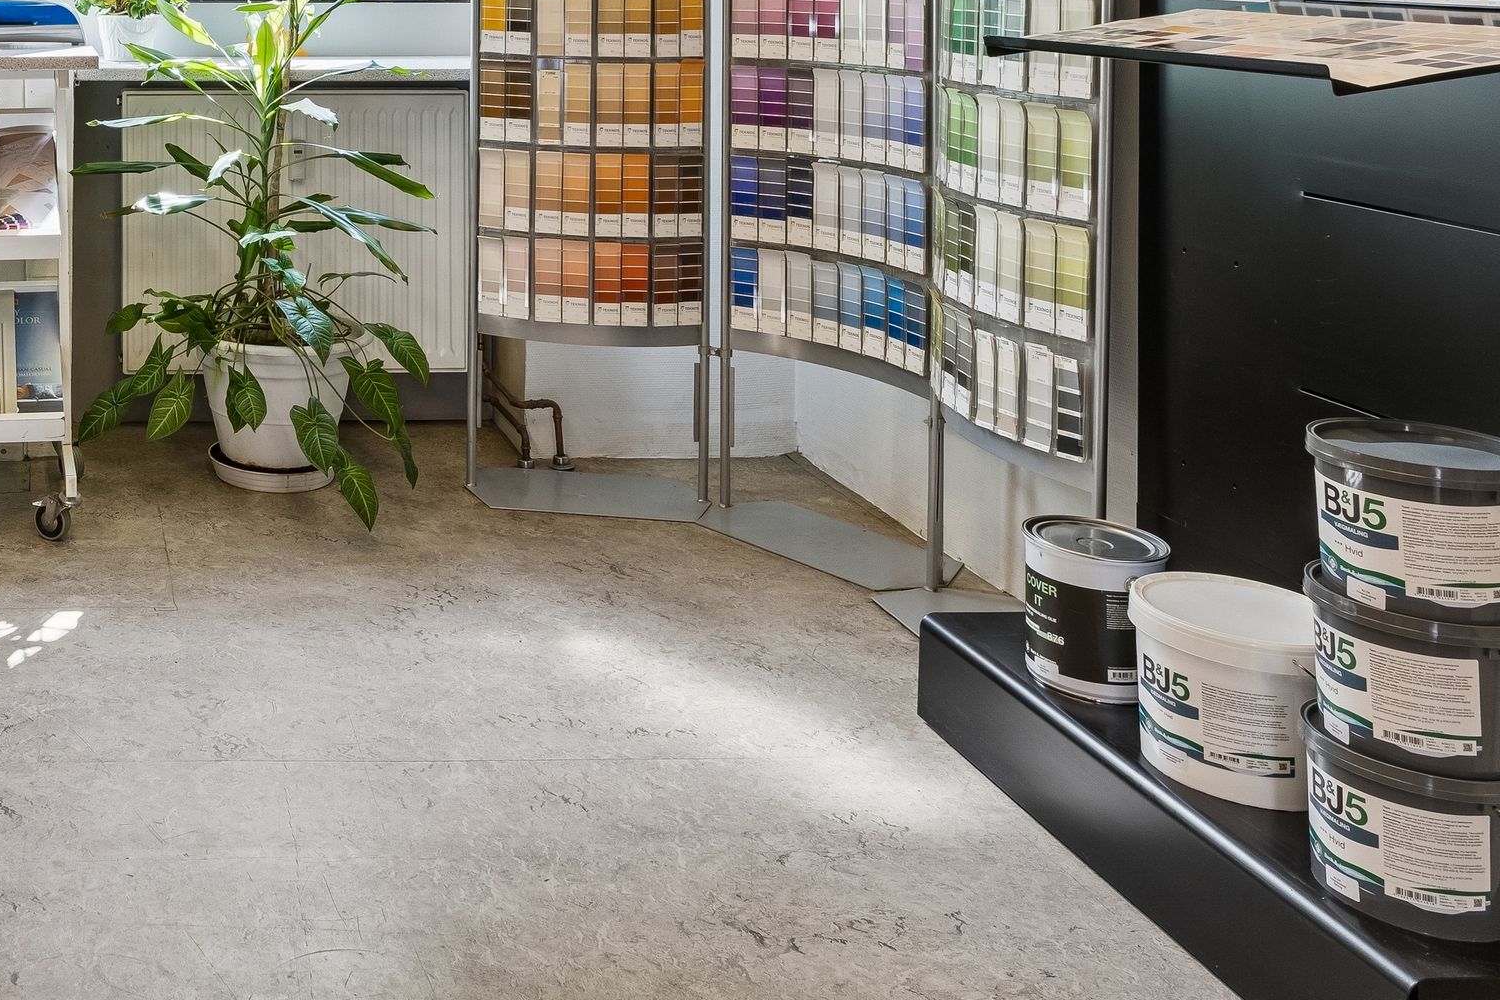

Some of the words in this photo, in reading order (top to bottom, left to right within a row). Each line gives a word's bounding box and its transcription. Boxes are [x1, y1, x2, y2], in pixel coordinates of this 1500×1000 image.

[15, 316, 41, 324] OLOR
[1324, 480, 1387, 531] B&J5
[1344, 544, 1364, 558] Hvid
[1026, 572, 1058, 598] COVER
[1034, 594, 1042, 606] IT
[1314, 618, 1357, 670] B&J5
[1142, 652, 1190, 702] B&J5
[1312, 766, 1368, 826] B&J5
[1328, 832, 1346, 850] Hvid
